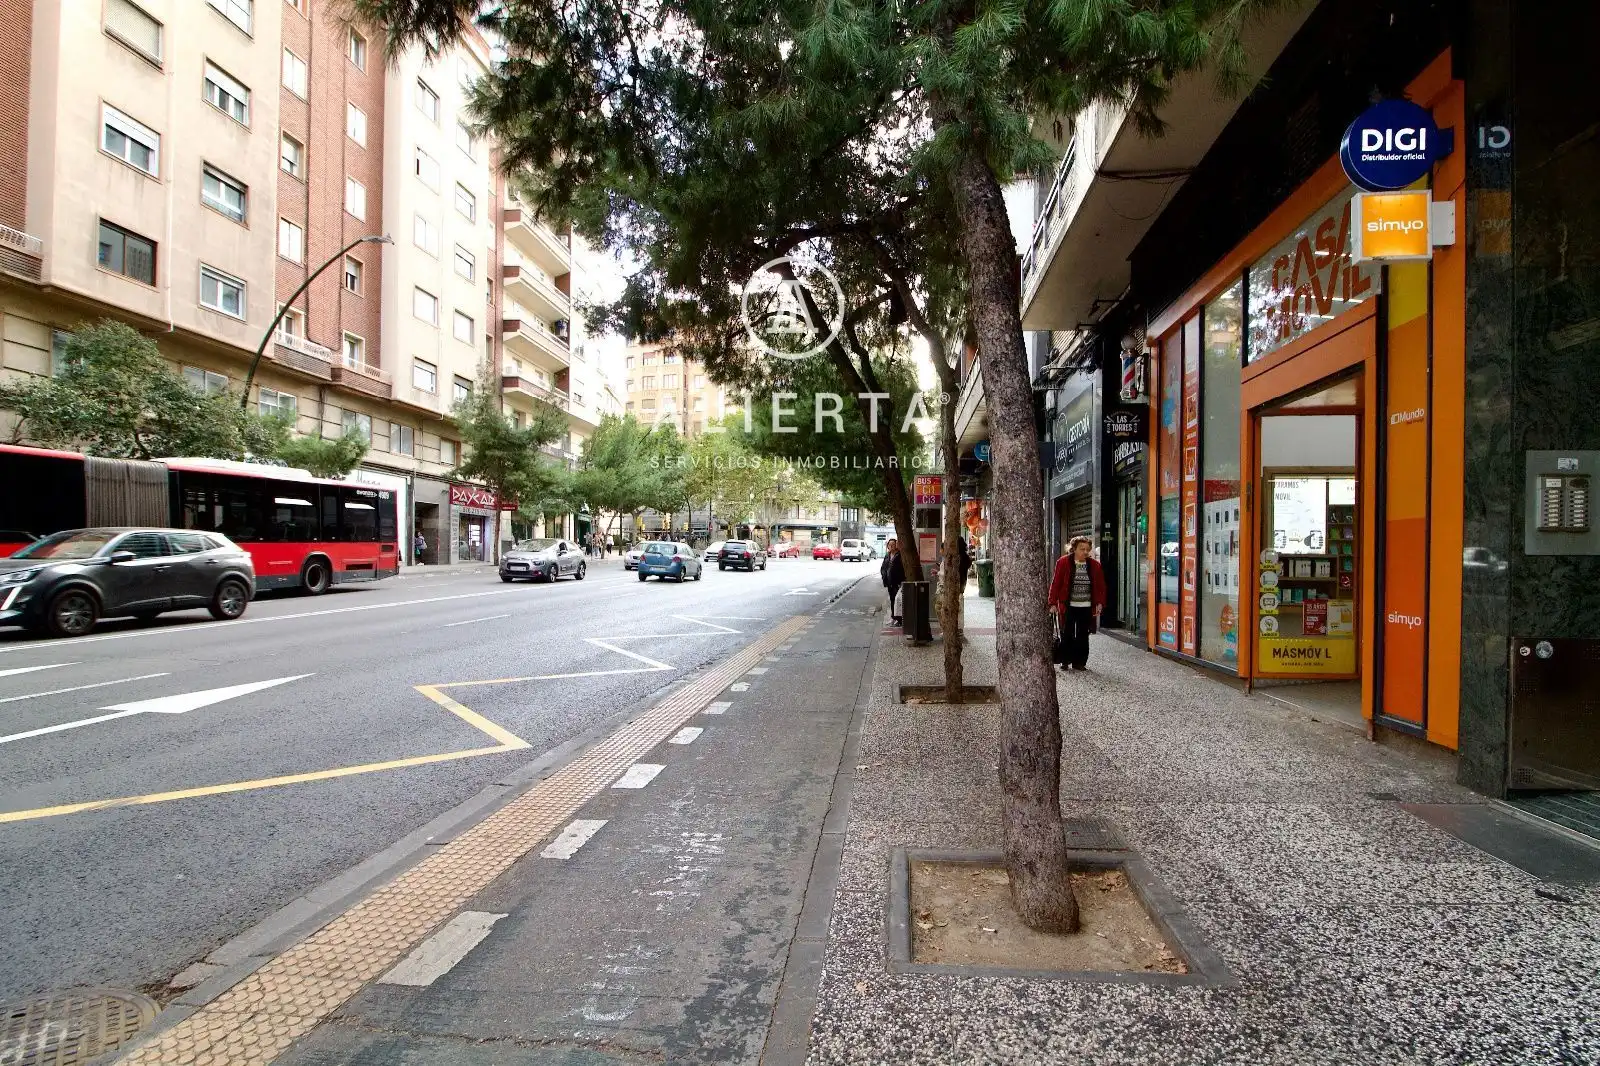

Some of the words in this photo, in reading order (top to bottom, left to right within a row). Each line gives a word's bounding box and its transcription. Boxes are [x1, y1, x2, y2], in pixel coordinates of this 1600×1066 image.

[1361, 128, 1426, 151] DIGI
[1361, 153, 1402, 161] Distribuidor
[1367, 218, 1424, 234] simyo
[1116, 415, 1128, 423] LAS
[1112, 423, 1133, 432] TORRES
[917, 477, 931, 485] BUS
[922, 495, 936, 504] Ci3
[1388, 611, 1422, 630] simyo
[1272, 645, 1332, 659] MÁSMÓVL
